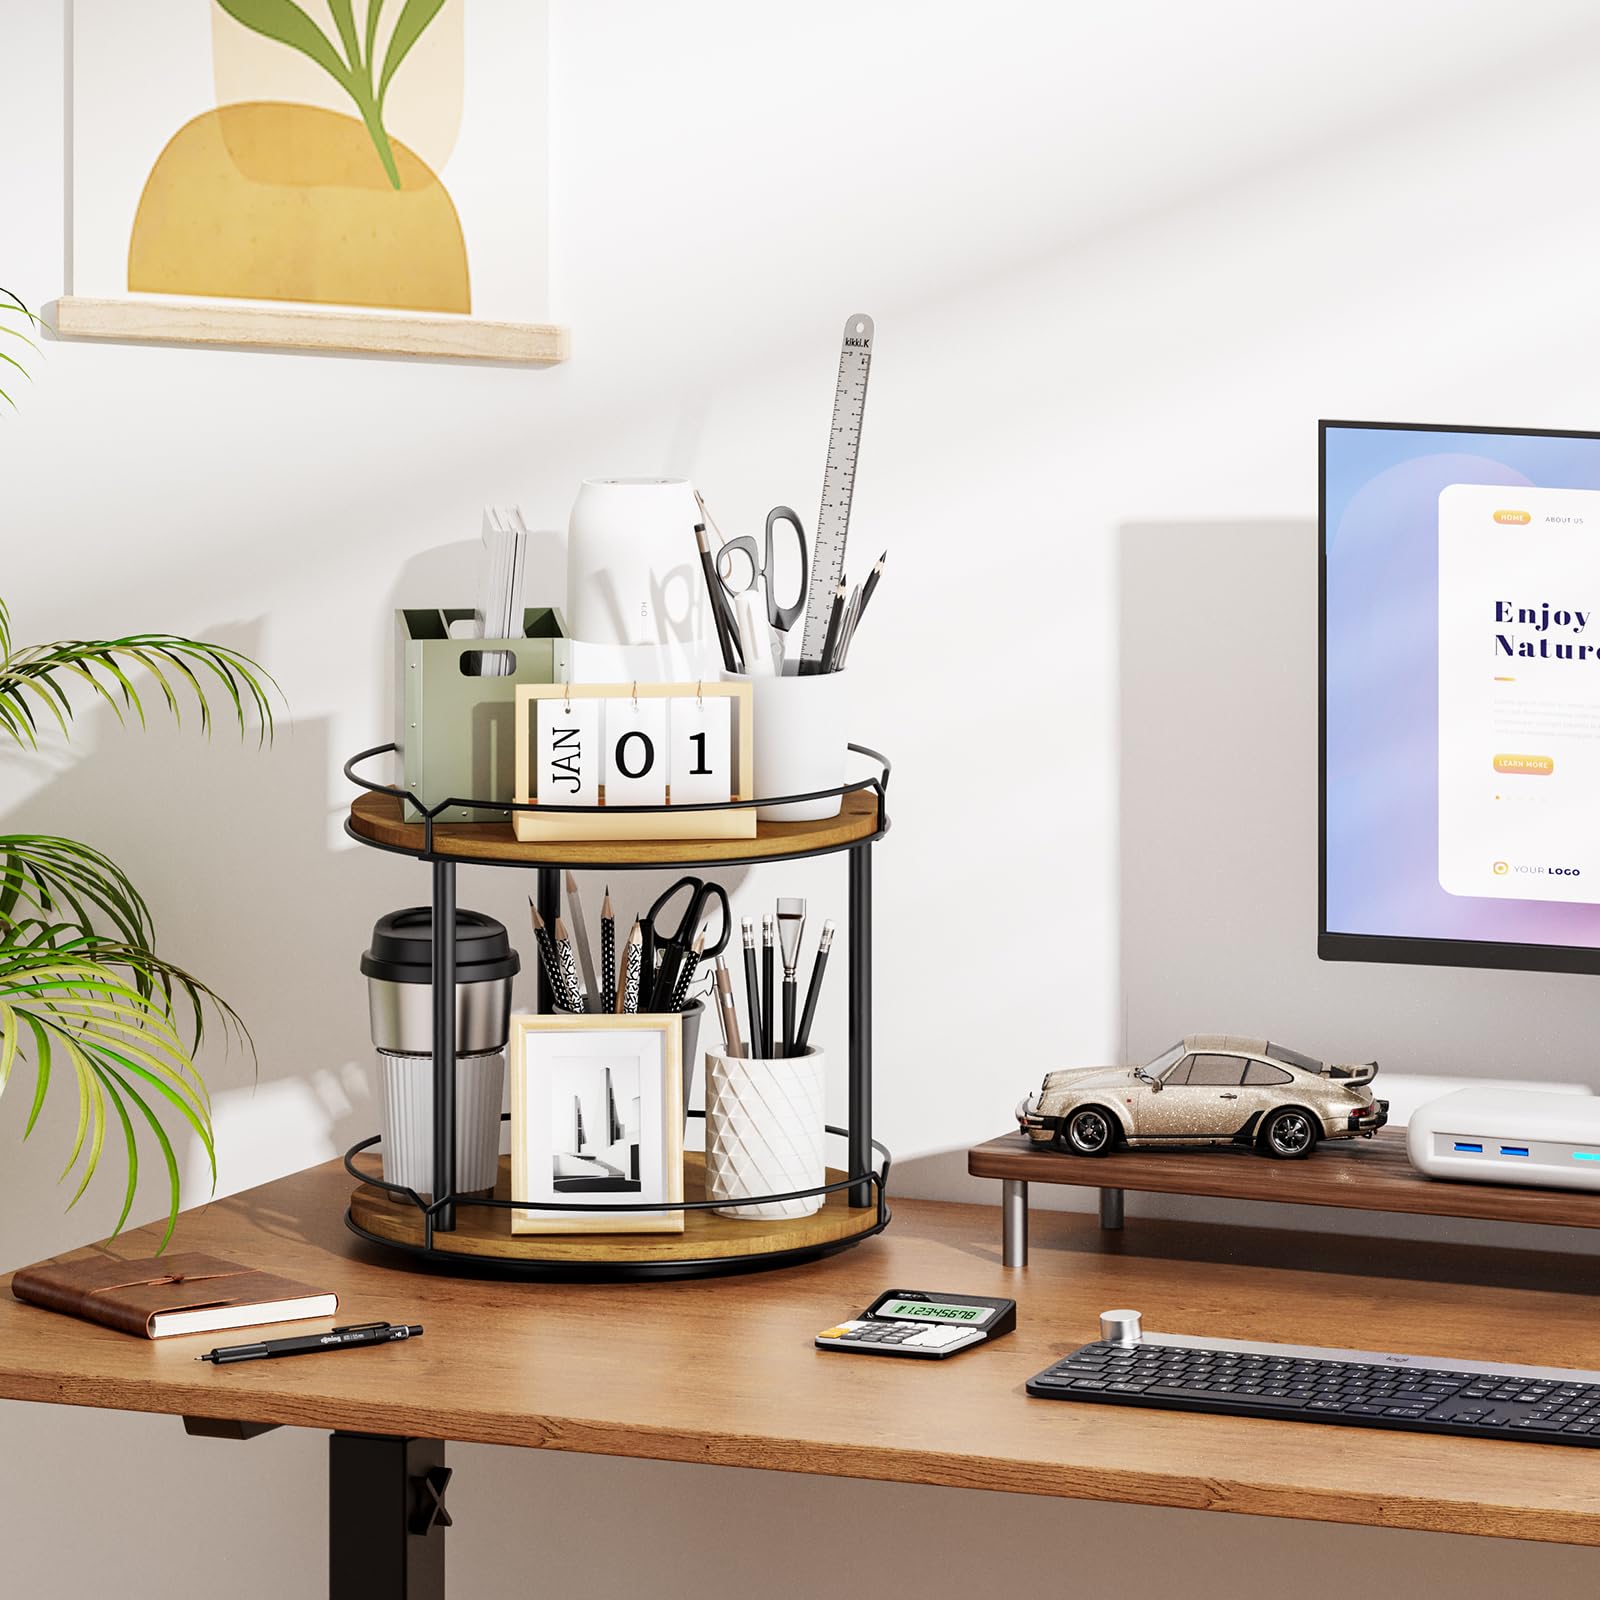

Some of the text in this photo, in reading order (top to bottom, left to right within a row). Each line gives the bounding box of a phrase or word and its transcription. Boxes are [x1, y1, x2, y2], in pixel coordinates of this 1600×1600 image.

[1500, 514, 1524, 522] HOME
[1495, 600, 1590, 633] Enjoy
[1495, 634, 1600, 660] Natur
[551, 727, 581, 794] JAN
[1498, 760, 1548, 769] LEARN MORE
[1514, 865, 1581, 876] YOUR LOGO
